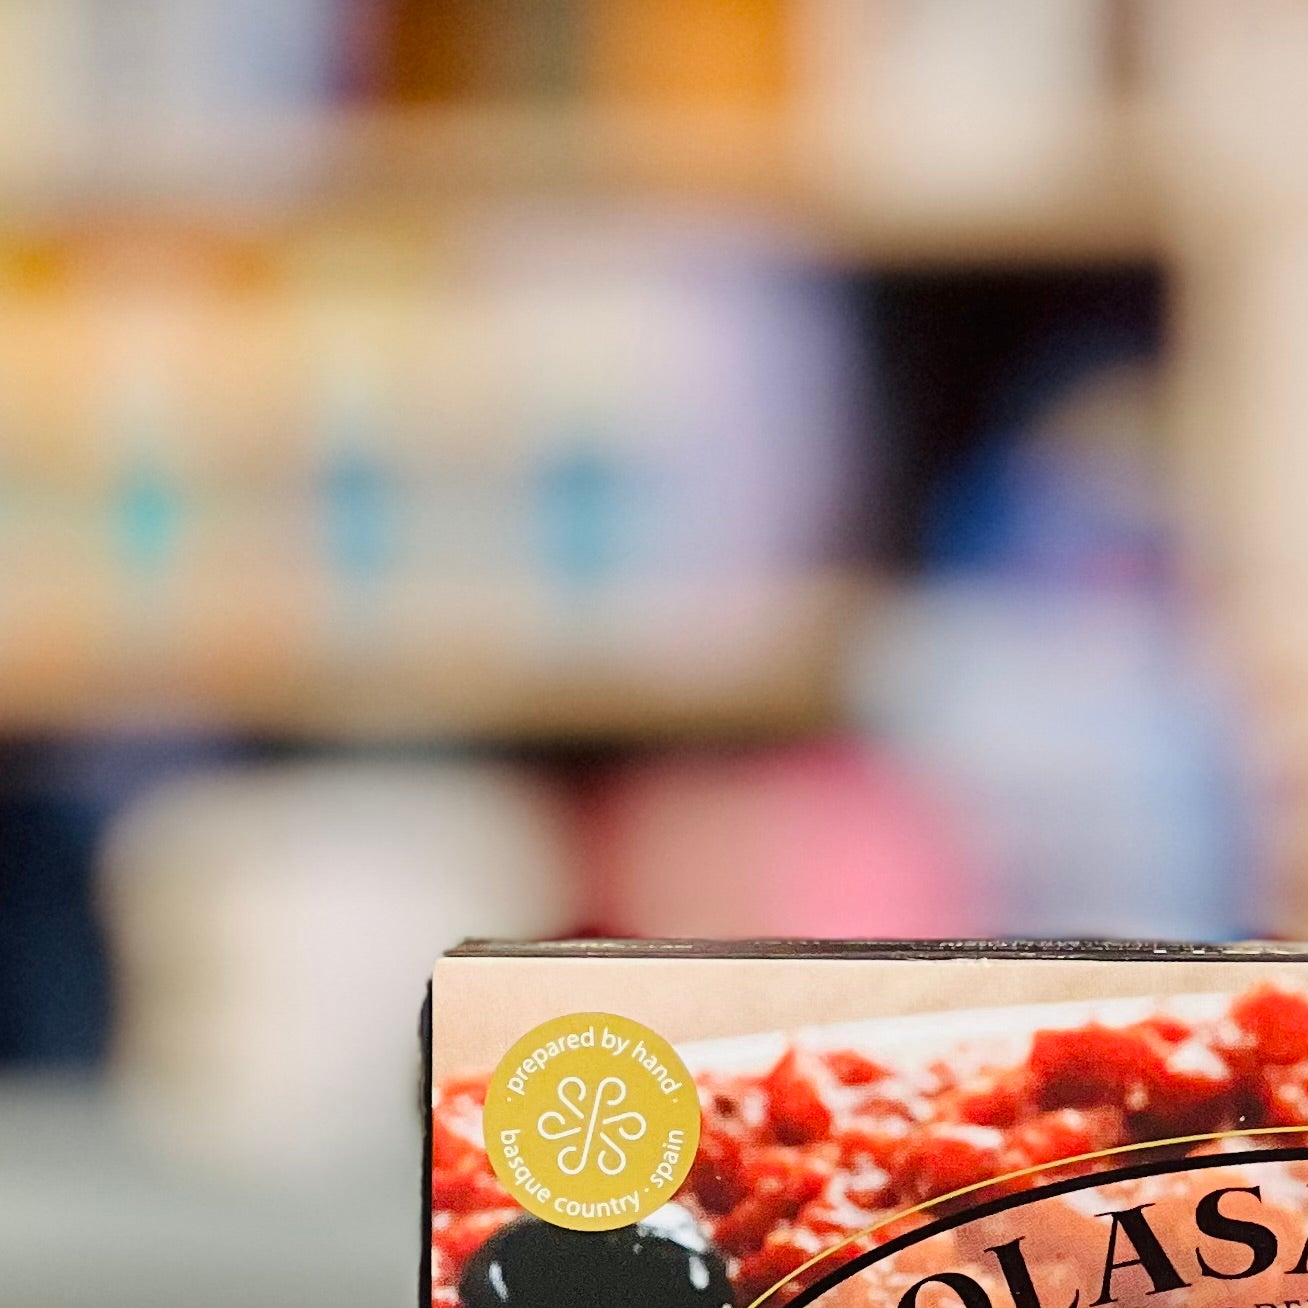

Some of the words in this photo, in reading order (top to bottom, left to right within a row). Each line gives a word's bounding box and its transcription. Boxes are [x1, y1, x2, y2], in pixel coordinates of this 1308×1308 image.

[507, 1026, 594, 1096] prepared
[601, 1027, 630, 1056] by
[631, 1040, 682, 1096] hand
[500, 1129, 551, 1204] basque
[554, 1190, 640, 1218] country
[650, 1129, 686, 1188] spain
